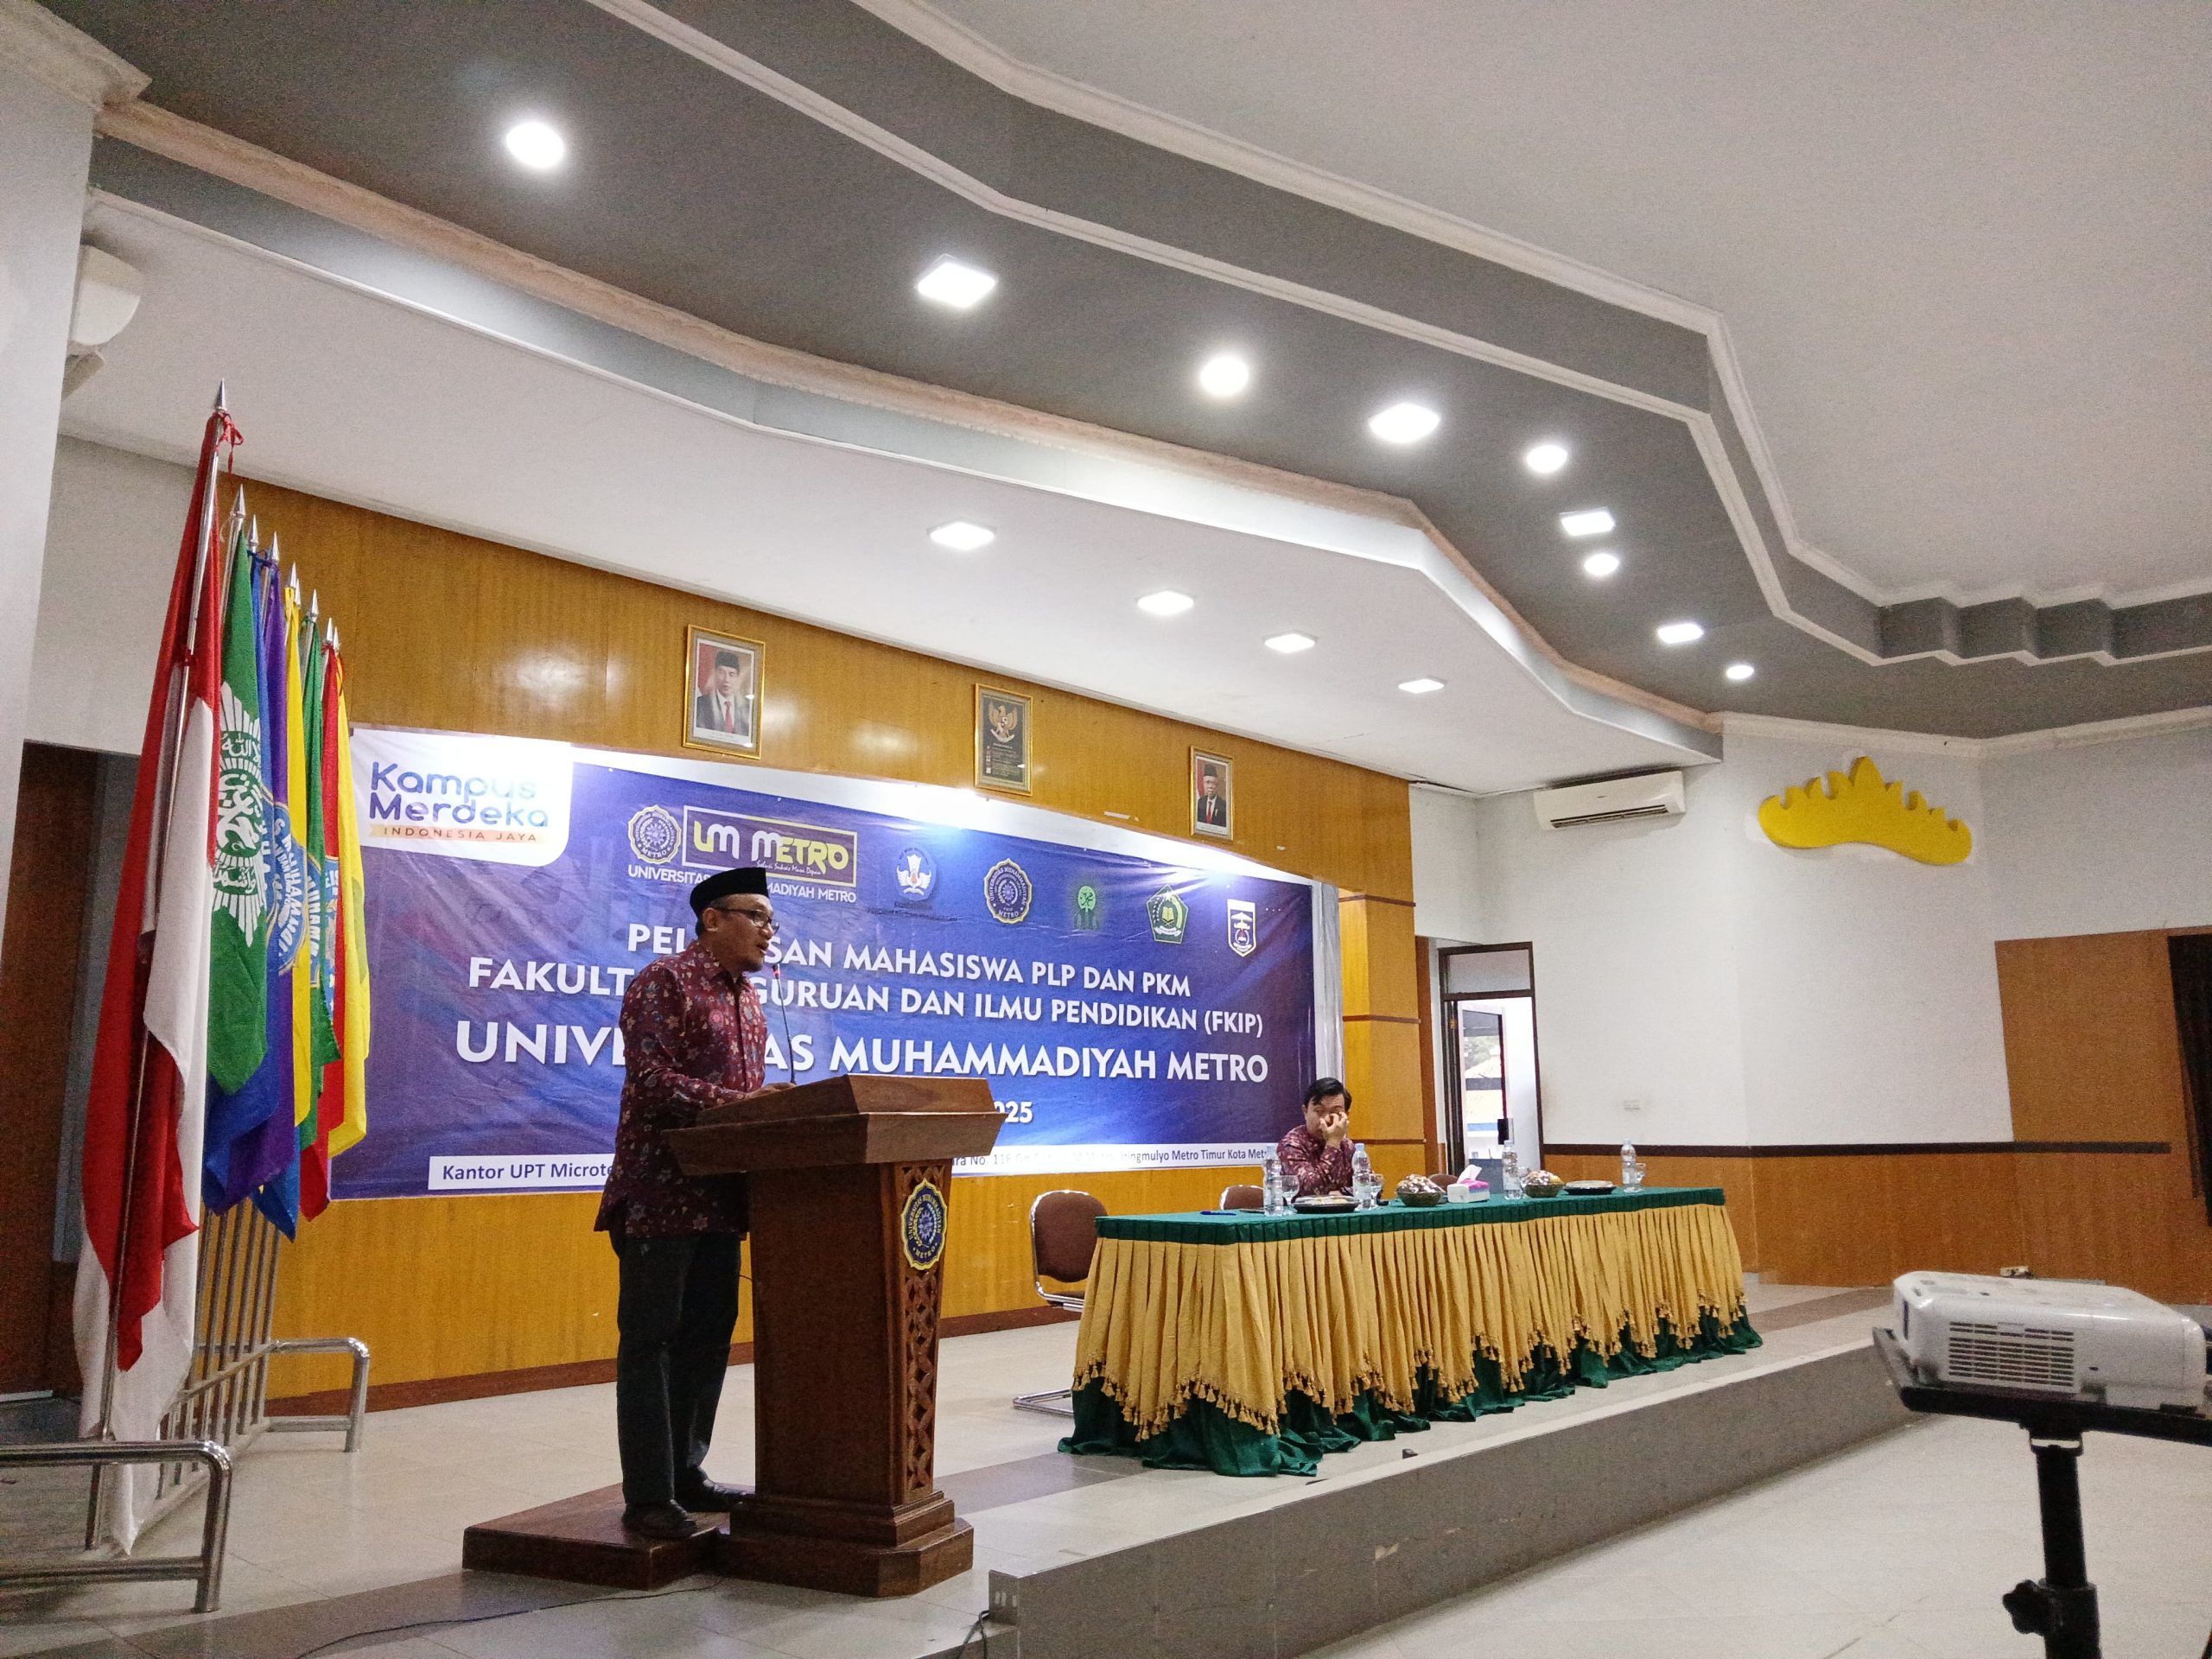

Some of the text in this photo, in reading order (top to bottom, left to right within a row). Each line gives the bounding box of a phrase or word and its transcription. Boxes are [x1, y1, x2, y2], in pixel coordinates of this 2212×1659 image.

[371, 760, 537, 804] Kampus
[369, 792, 549, 827] Merdeka
[383, 827, 537, 842] INDONESIA JAYA
[751, 830, 849, 875] METRO
[818, 888, 856, 903] METRO
[843, 944, 1024, 983] MAHASISWA
[1032, 962, 1076, 987] PLP
[1084, 966, 1134, 993] DAN
[1142, 972, 1191, 997] PKM
[901, 988, 964, 1017] DAN
[976, 993, 1041, 1021] ILMU
[1052, 999, 1197, 1031] PENDIDIKAN
[1205, 1010, 1263, 1038] (FKIP)
[830, 1036, 1156, 1078] MUHAMMADIYAH
[1167, 1051, 1268, 1083] METRO
[442, 1164, 505, 1180] Kantor
[510, 1164, 545, 1179] UPT
[1172, 1150, 1198, 1160] Metro
[1201, 1149, 1224, 1160] Timur
[1228, 1149, 1246, 1159] Kota
